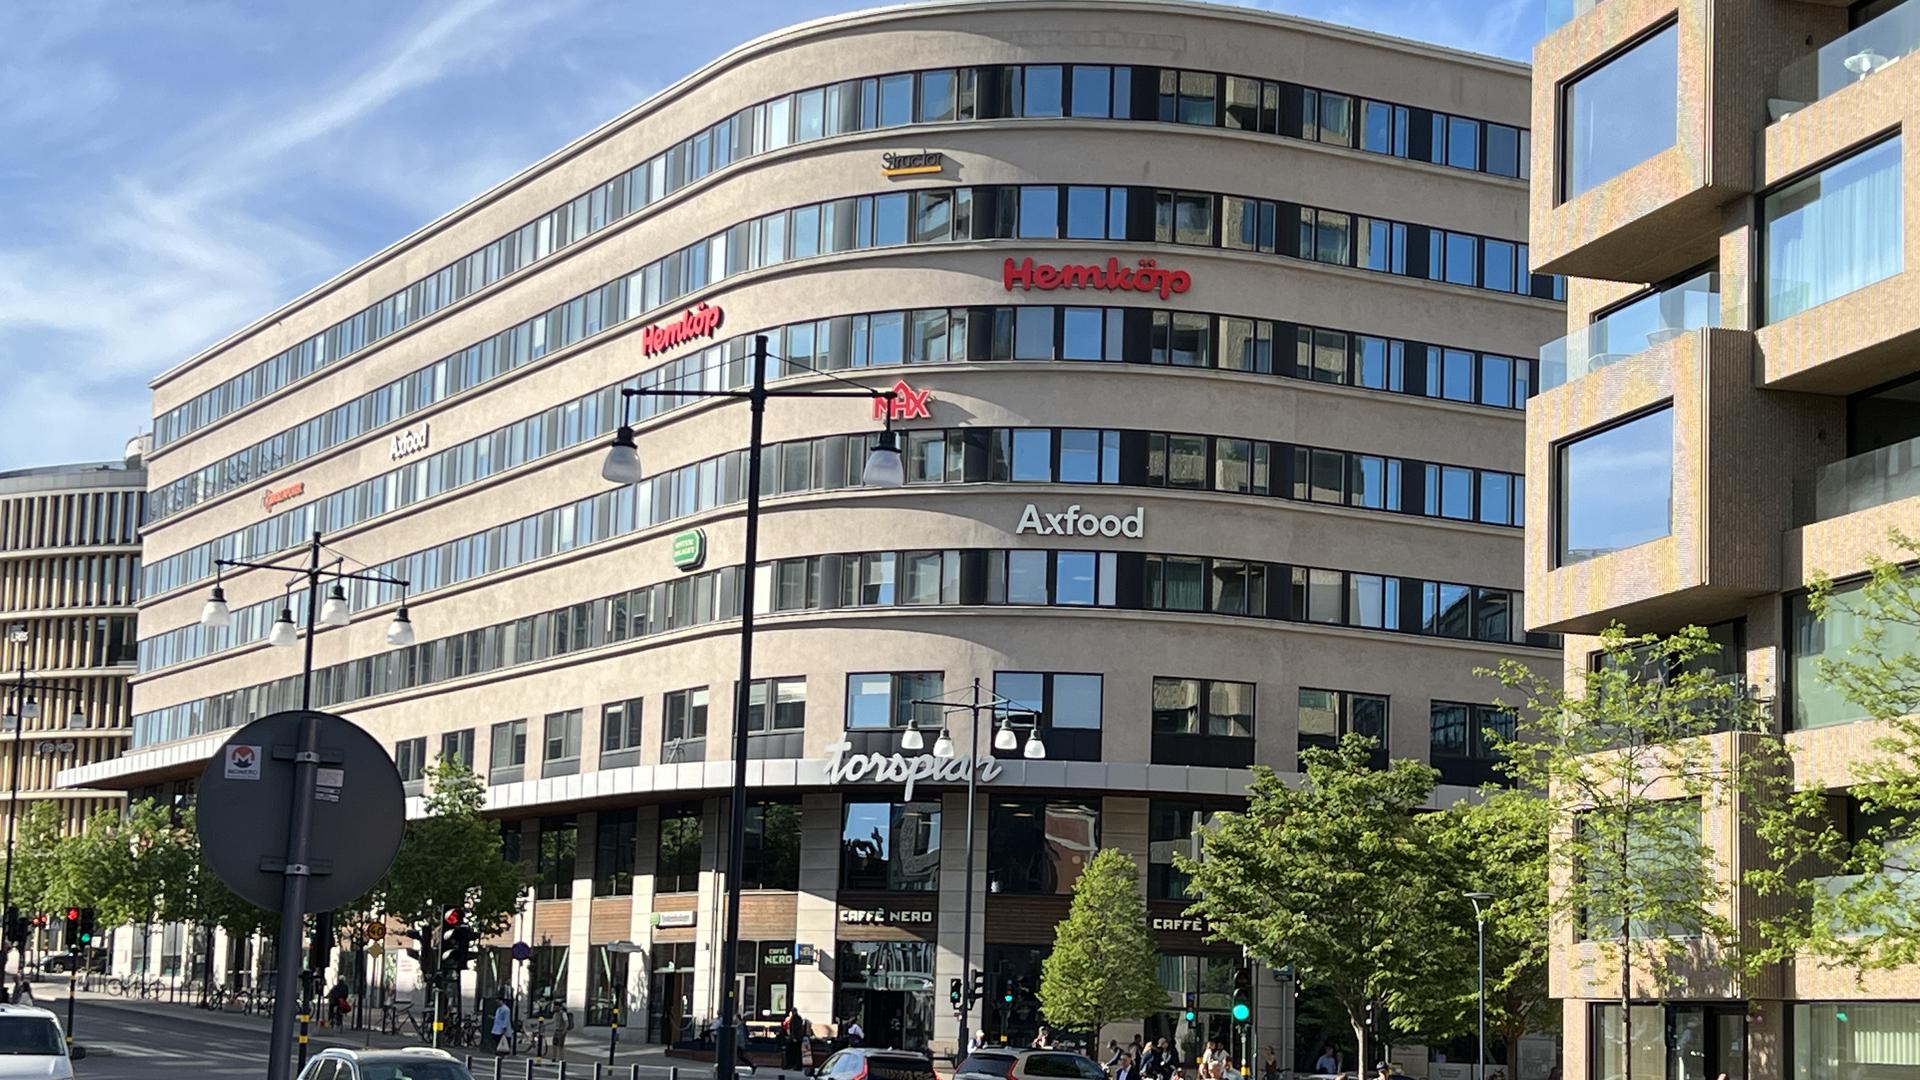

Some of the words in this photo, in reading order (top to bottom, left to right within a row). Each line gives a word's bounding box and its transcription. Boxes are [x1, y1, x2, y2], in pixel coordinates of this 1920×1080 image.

[881, 146, 943, 170] Structor
[1004, 256, 1191, 300] Hemköp
[642, 301, 720, 356] Hemköp
[390, 422, 429, 460] Axfood
[1016, 503, 1144, 538] Axfood
[890, 911, 932, 922] NERO
[764, 954, 793, 965] NERO
